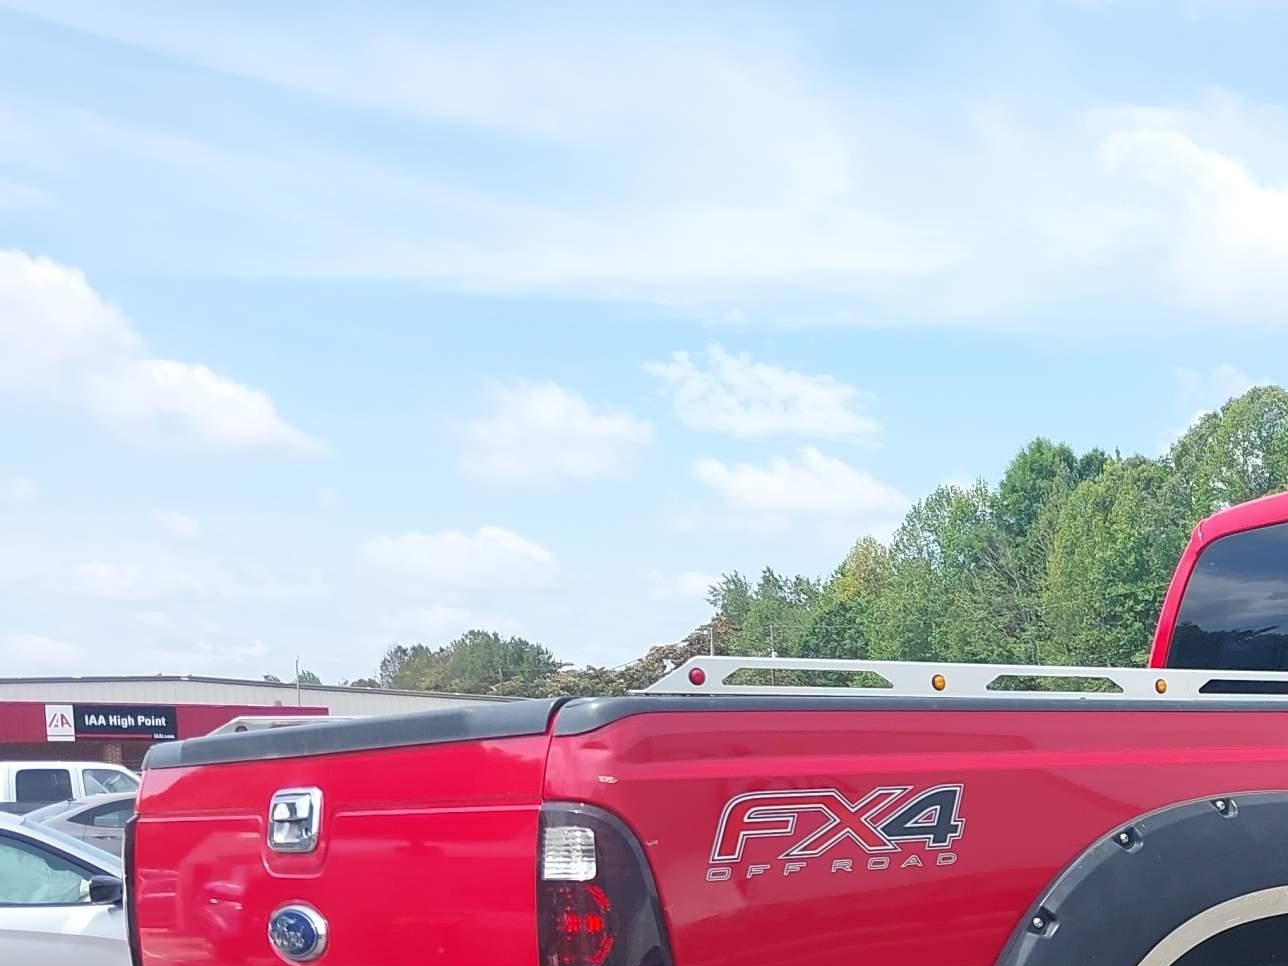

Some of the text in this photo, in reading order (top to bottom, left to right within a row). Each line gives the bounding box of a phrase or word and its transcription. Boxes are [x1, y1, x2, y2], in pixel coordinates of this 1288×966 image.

[84, 714, 166, 729] IAA High Point
[709, 783, 965, 864] FX4
[705, 851, 958, 882] OFF ROAD
